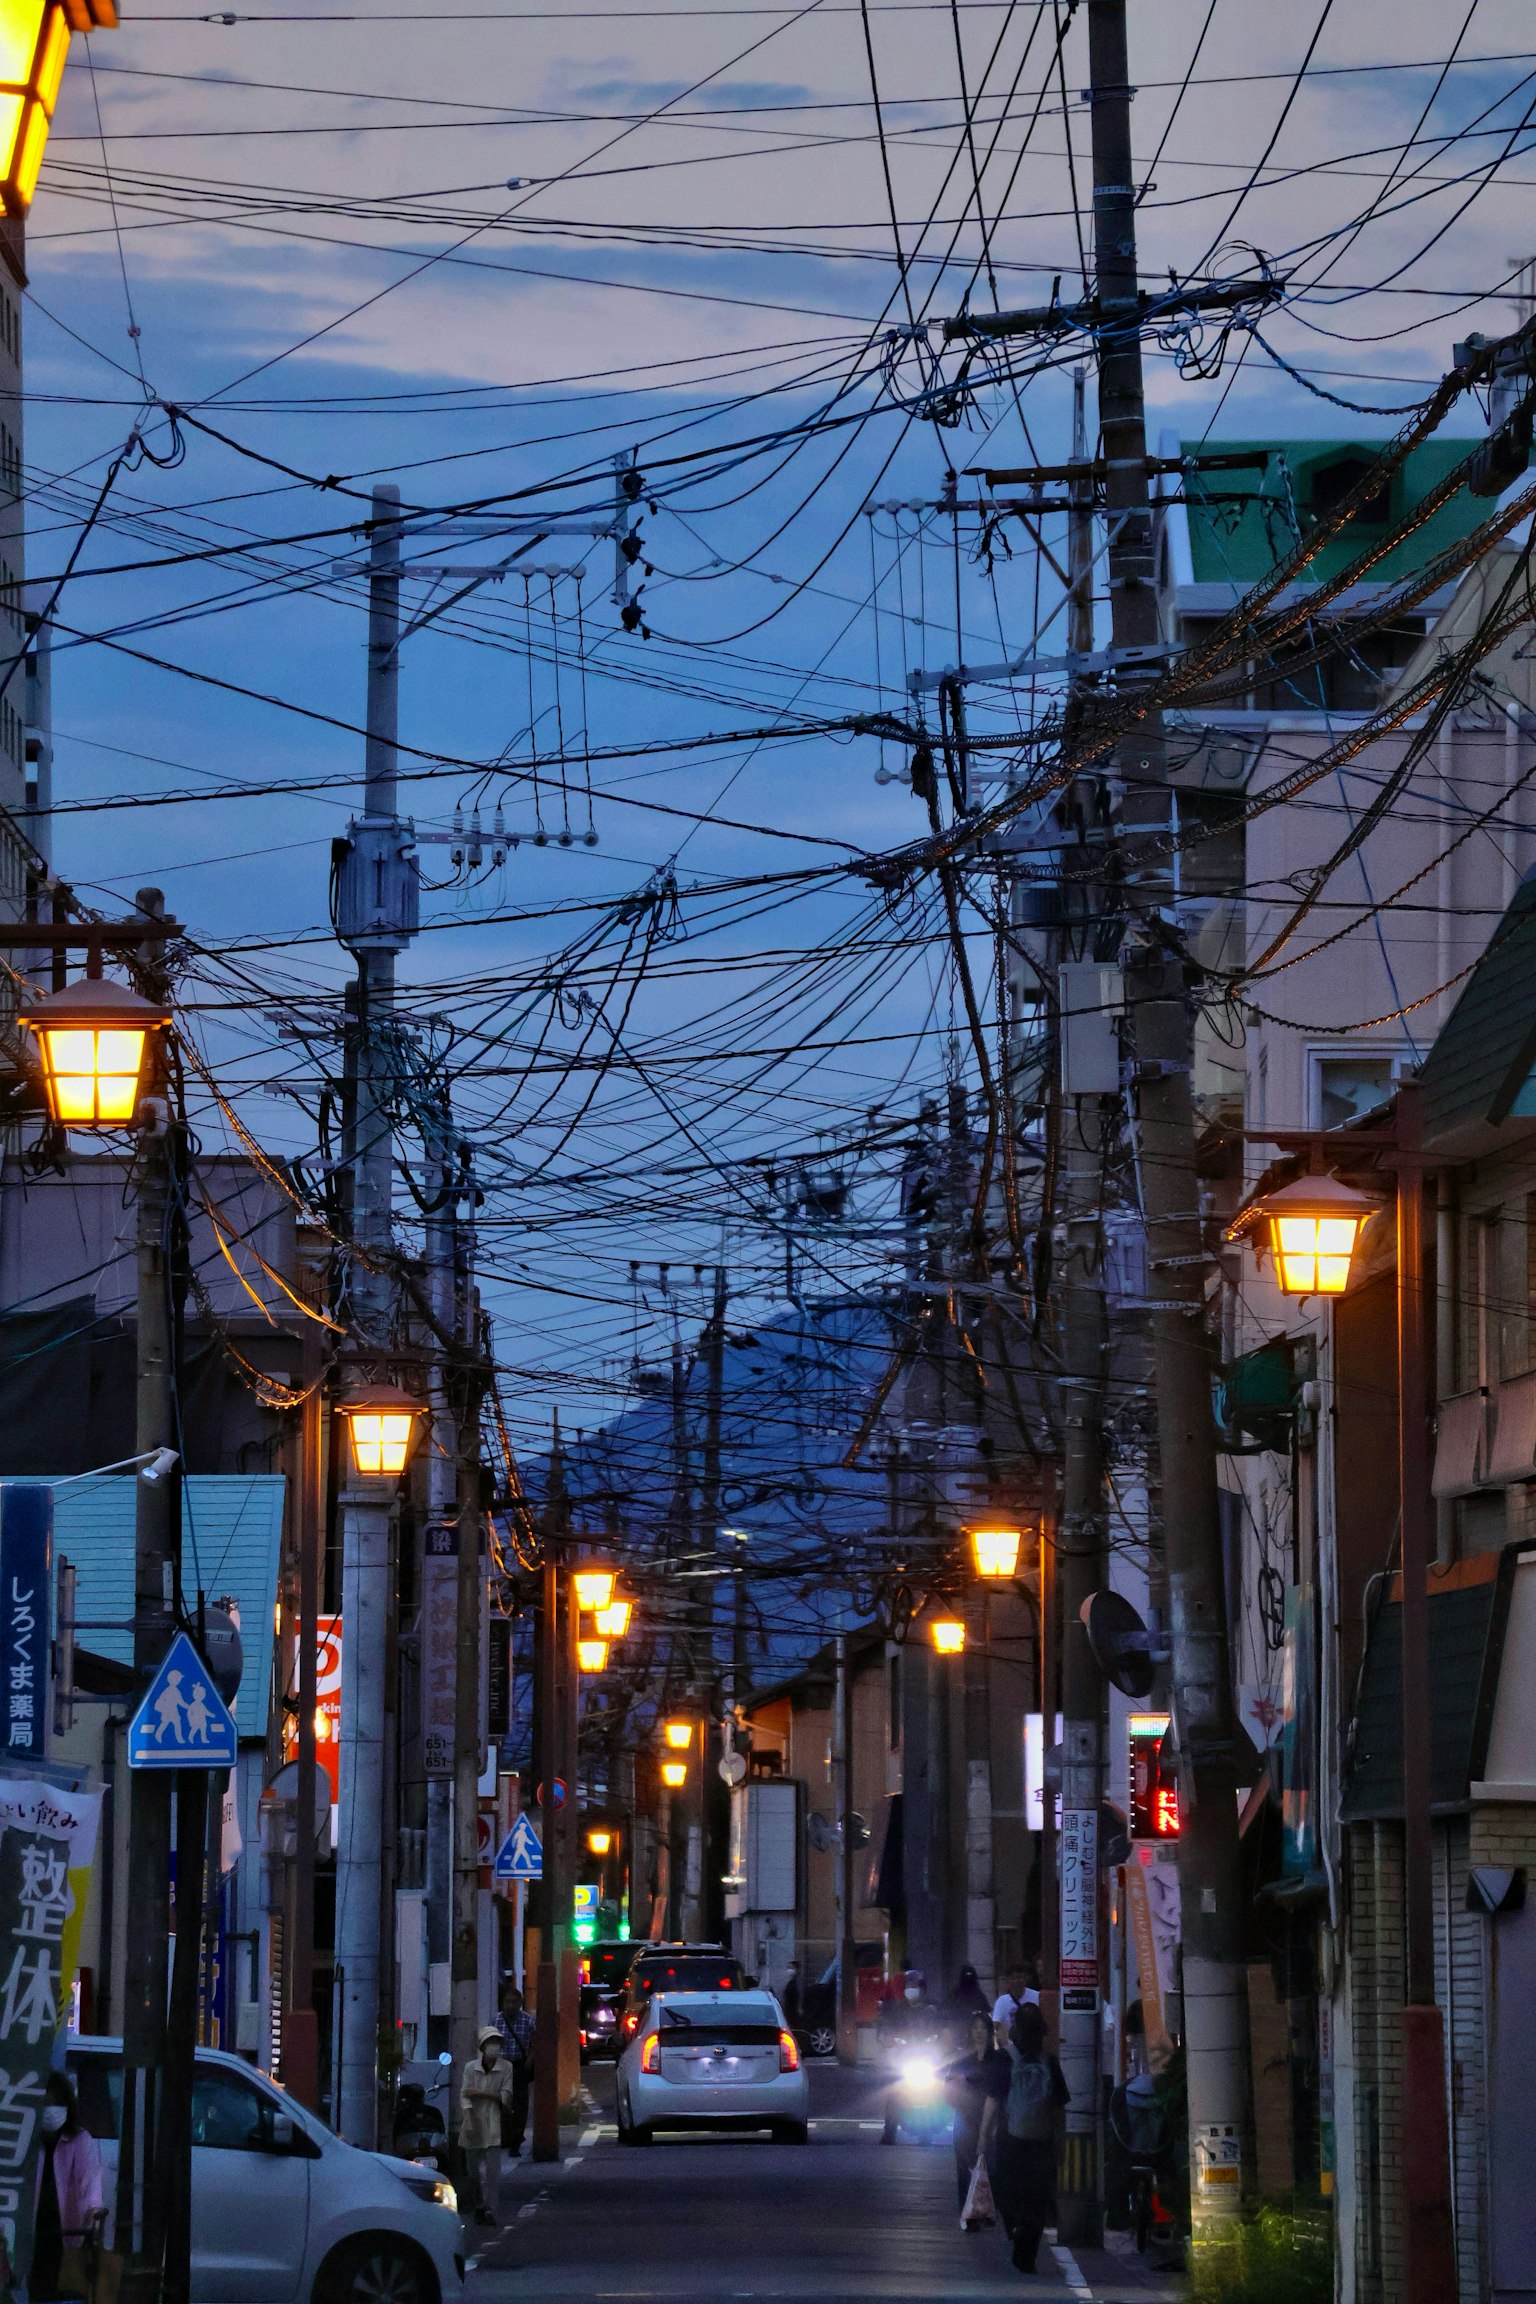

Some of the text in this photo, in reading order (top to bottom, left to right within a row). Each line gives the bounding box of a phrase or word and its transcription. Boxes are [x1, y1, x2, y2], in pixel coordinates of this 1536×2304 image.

[8, 1576, 35, 1747] しろくま薬局
[1064, 1814, 1079, 1956] 頭痛クリニック
[1081, 1815, 1095, 1956] よしむら脳神経外科
